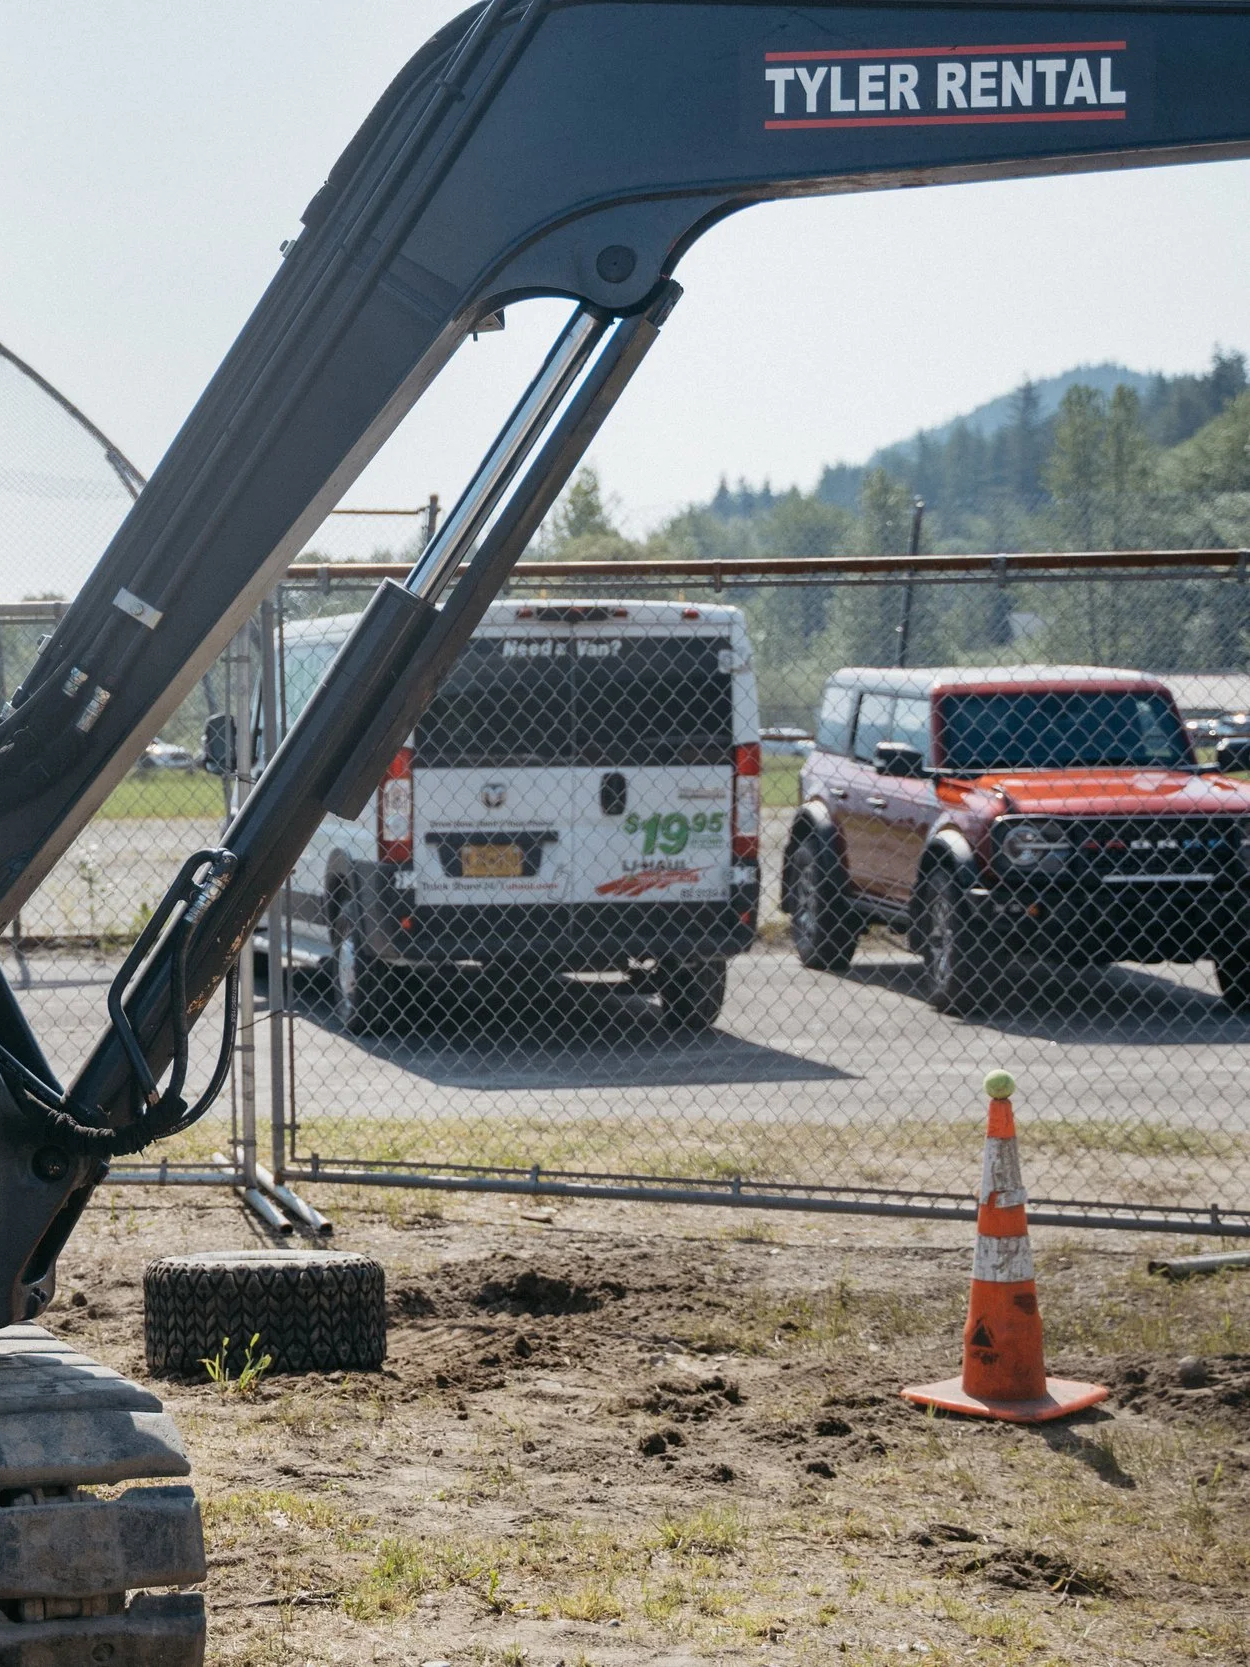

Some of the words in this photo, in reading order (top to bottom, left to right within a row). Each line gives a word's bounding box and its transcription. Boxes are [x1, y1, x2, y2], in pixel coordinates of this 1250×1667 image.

[765, 64, 920, 114] TYLER
[937, 57, 1127, 109] RENTAL
[502, 639, 554, 658] Need
[576, 639, 623, 657] Van?
